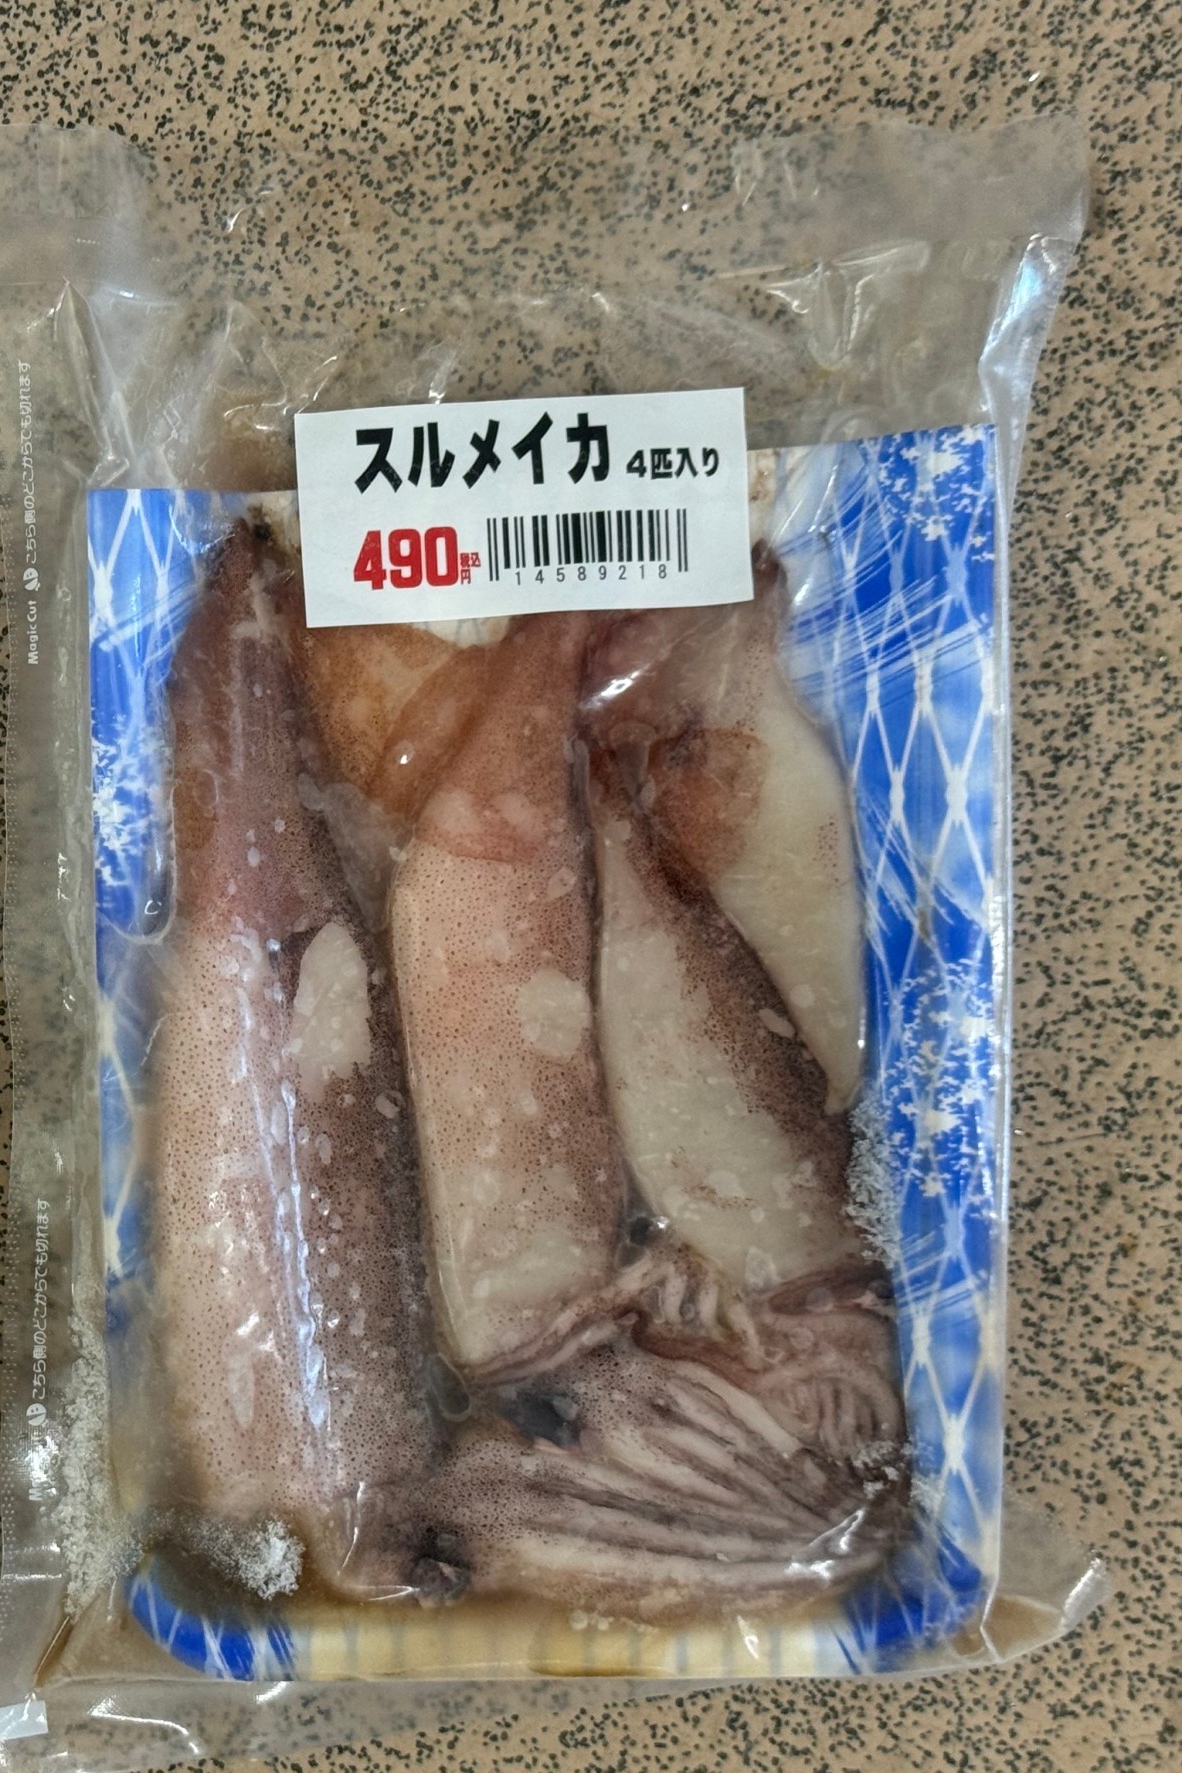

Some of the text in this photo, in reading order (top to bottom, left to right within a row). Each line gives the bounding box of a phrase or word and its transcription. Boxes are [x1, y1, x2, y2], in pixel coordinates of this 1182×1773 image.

[354, 410, 720, 494] スルメイカ 4匹入り
[353, 526, 459, 590] 490
[27, 600, 39, 665] Magic Cut
[32, 1199, 50, 1400] こちら側のどこからでも切れます
